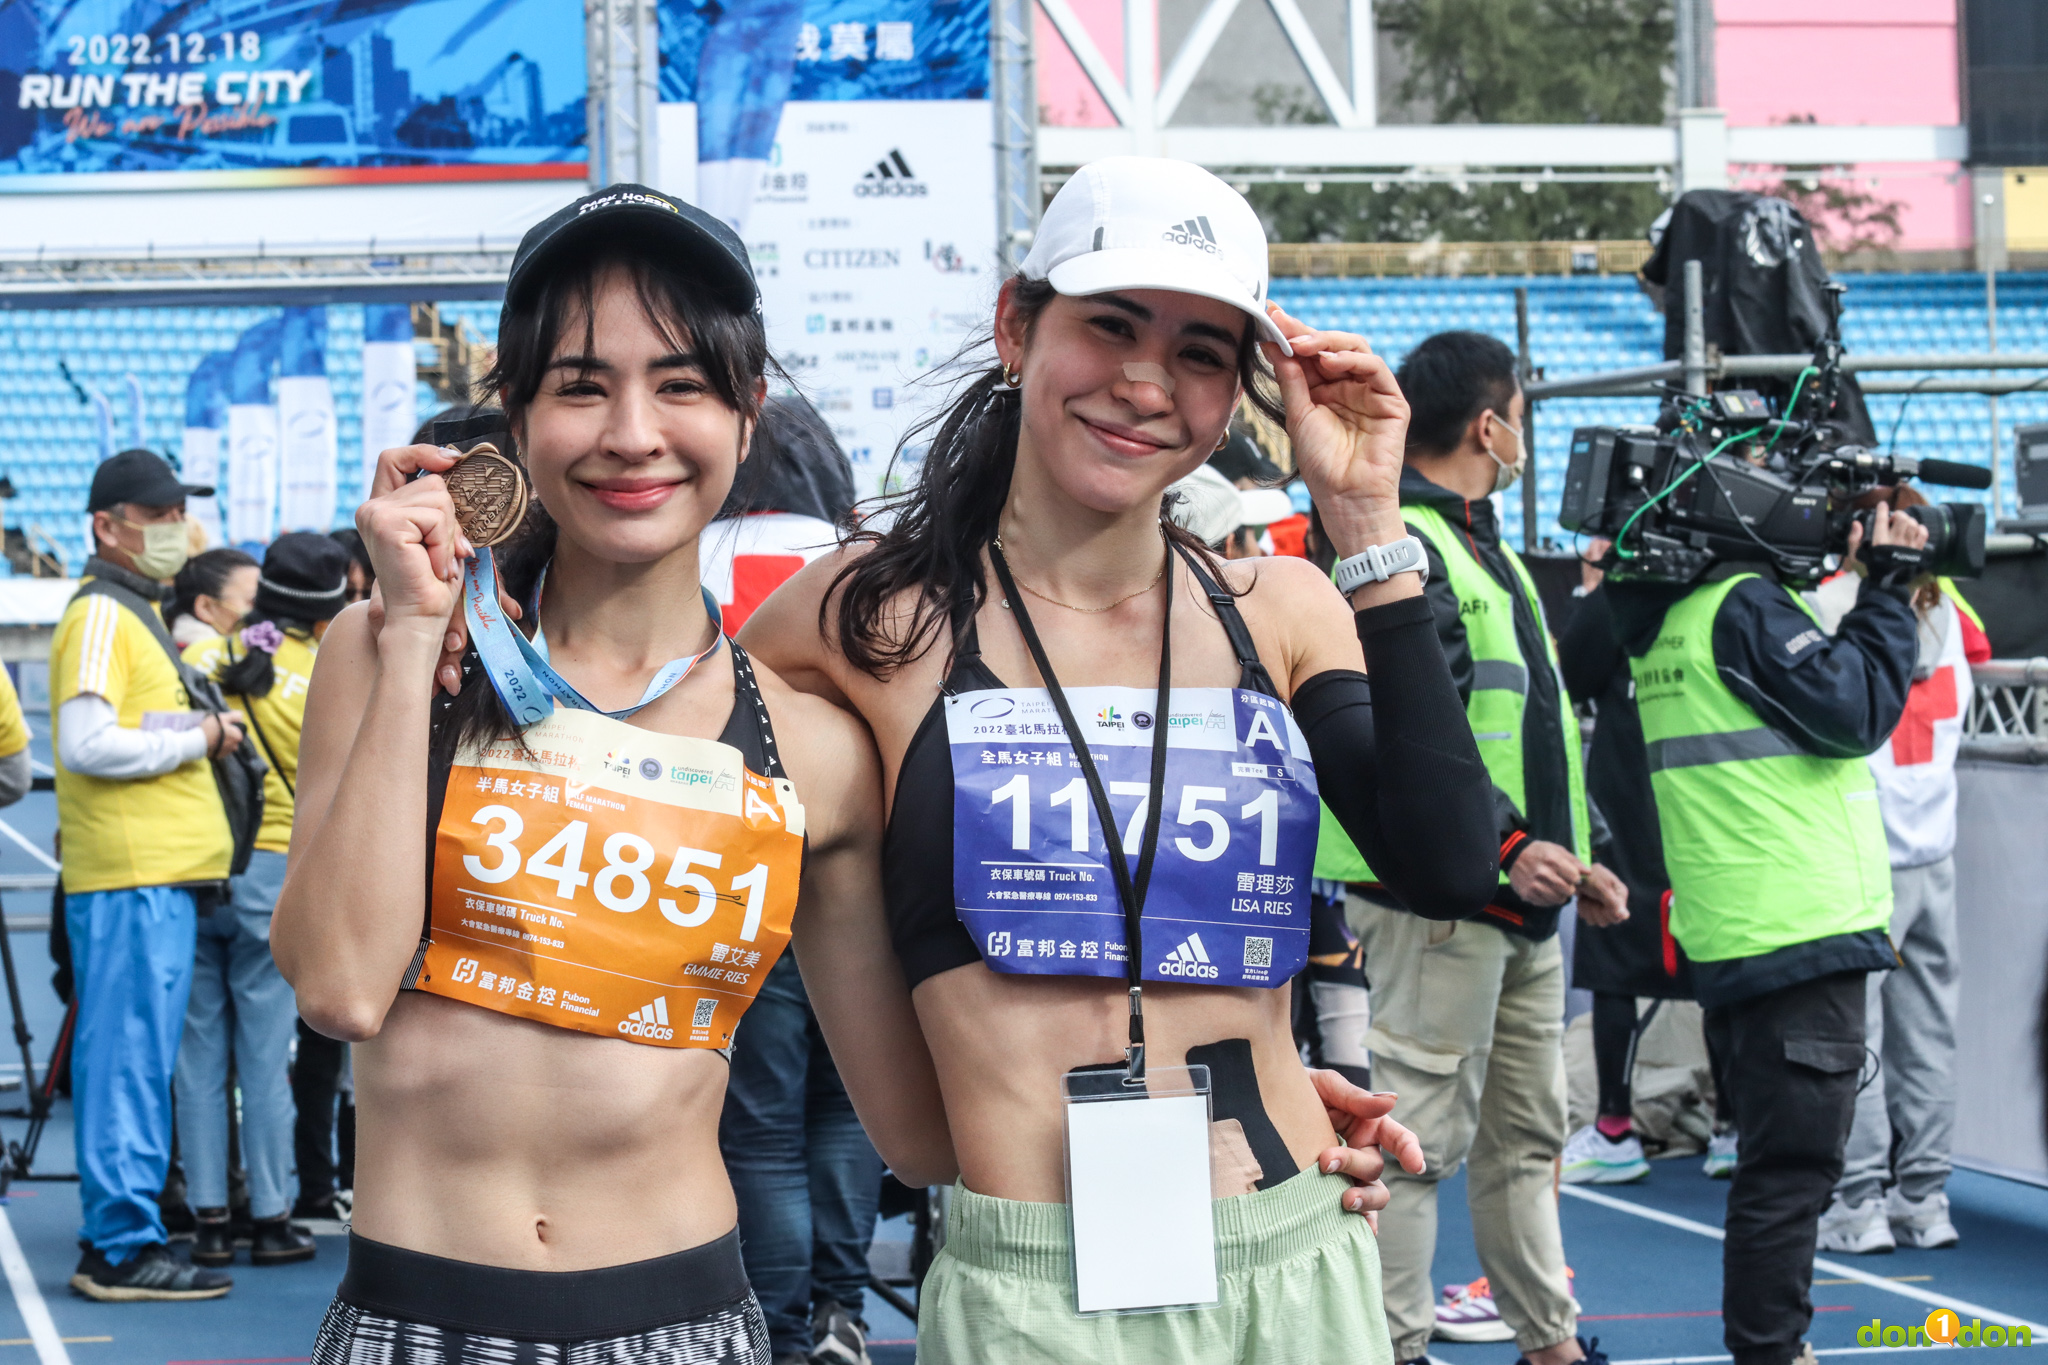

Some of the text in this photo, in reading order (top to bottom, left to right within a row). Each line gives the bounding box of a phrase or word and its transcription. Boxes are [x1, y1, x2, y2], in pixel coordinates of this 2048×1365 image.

[68, 31, 261, 65] 2022.12.18
[18, 68, 313, 109] RUN THE CITY
[63, 91, 279, 143] We are Possible
[853, 182, 929, 198] adidas
[1162, 231, 1225, 261] adidas
[803, 248, 901, 269] CITIZEN
[504, 669, 527, 701] 2022
[537, 722, 567, 731] TAIPEI
[1096, 721, 1125, 729] TAIPEI
[1168, 718, 1204, 729] aipei
[1244, 710, 1285, 751] A
[535, 731, 585, 744] MARATHON
[980, 750, 1063, 767] 全馬女子組
[671, 766, 713, 786] taipei
[1277, 768, 1284, 778] S
[475, 776, 560, 804] 半馬女子組
[565, 800, 593, 813] FEMALE
[585, 796, 626, 812] MARATHON
[745, 787, 781, 823] A
[991, 774, 1279, 867] 11751
[462, 804, 769, 943] 34851
[990, 868, 1096, 883] 衣保車號碼 Truck No.
[1237, 872, 1295, 896] 雷理莎
[1054, 893, 1098, 902] 0974-153-833
[1231, 898, 1293, 916] LISA RIES
[465, 897, 566, 929] 衣保車號碼 Truck No.
[522, 932, 565, 949] 0974-153-833
[1016, 938, 1099, 959] 富邦金控
[709, 942, 762, 969] 雷艾美
[1104, 952, 1130, 962] Financ
[683, 963, 751, 985] EMMIE RIES
[1158, 959, 1219, 979] adidas
[478, 970, 557, 1007] 富邦金控
[562, 990, 591, 1004] Fubon
[560, 1000, 601, 1018] Financial
[617, 1018, 674, 1041] adidas
